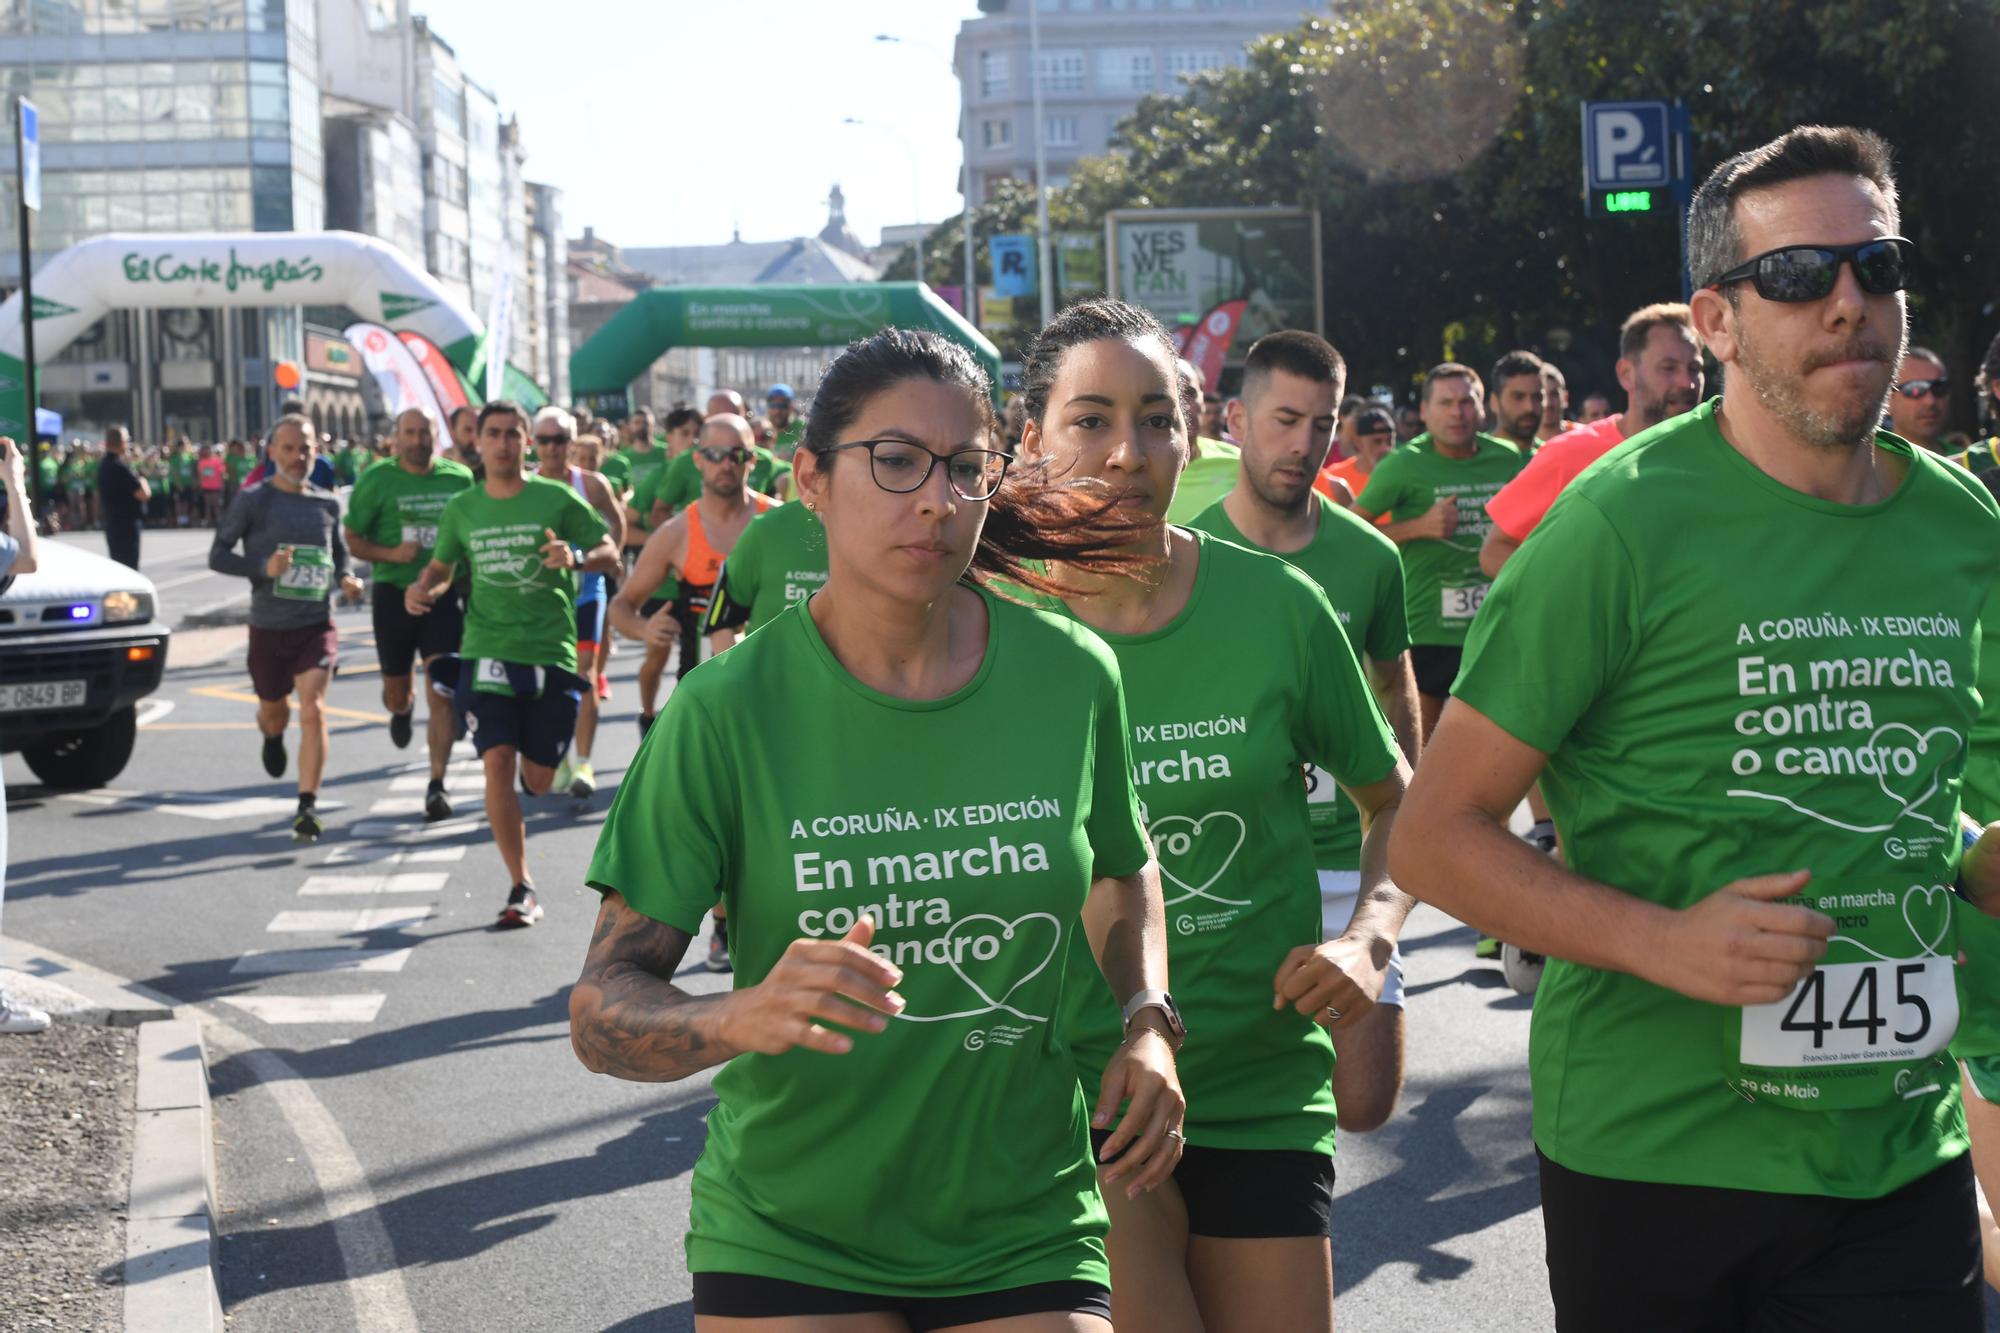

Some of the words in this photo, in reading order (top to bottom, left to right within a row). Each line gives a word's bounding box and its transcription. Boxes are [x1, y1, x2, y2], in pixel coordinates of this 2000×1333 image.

[1595, 110, 1644, 180] P
[1131, 230, 1186, 255] YES
[123, 253, 150, 281] El
[154, 253, 220, 282] Corte
[226, 248, 323, 292] Inglés
[1132, 251, 1174, 273] WE
[1134, 272, 1187, 293] FAN
[785, 570, 793, 579] A
[784, 583, 807, 600] En
[1454, 583, 1491, 613] 36
[1736, 623, 1755, 645] A
[1861, 616, 1884, 637] IX
[1885, 612, 1962, 638] EDICIÓN
[1738, 656, 1797, 697] En
[1809, 648, 1956, 690] marcha
[14, 685, 56, 707] 0849
[61, 683, 82, 703] BP
[1136, 725, 1156, 743] IX
[1160, 714, 1247, 742] EDICIÓN
[1734, 694, 1874, 736] contra
[1133, 749, 1232, 786] rcha
[1731, 748, 1763, 776] o
[790, 819, 808, 839] A
[933, 807, 959, 829] IX
[963, 795, 1061, 826] EDICIÓN
[793, 852, 854, 892] En
[867, 836, 1050, 886] marcha
[1819, 896, 1838, 909] en
[1841, 888, 1897, 908] marcha
[798, 893, 951, 937] contra
[1836, 914, 1869, 928] ncro
[870, 933, 1000, 966] ancro
[1781, 963, 1932, 1049] 445
[1761, 1081, 1780, 1096] de
[1784, 1083, 1820, 1099] Maio
